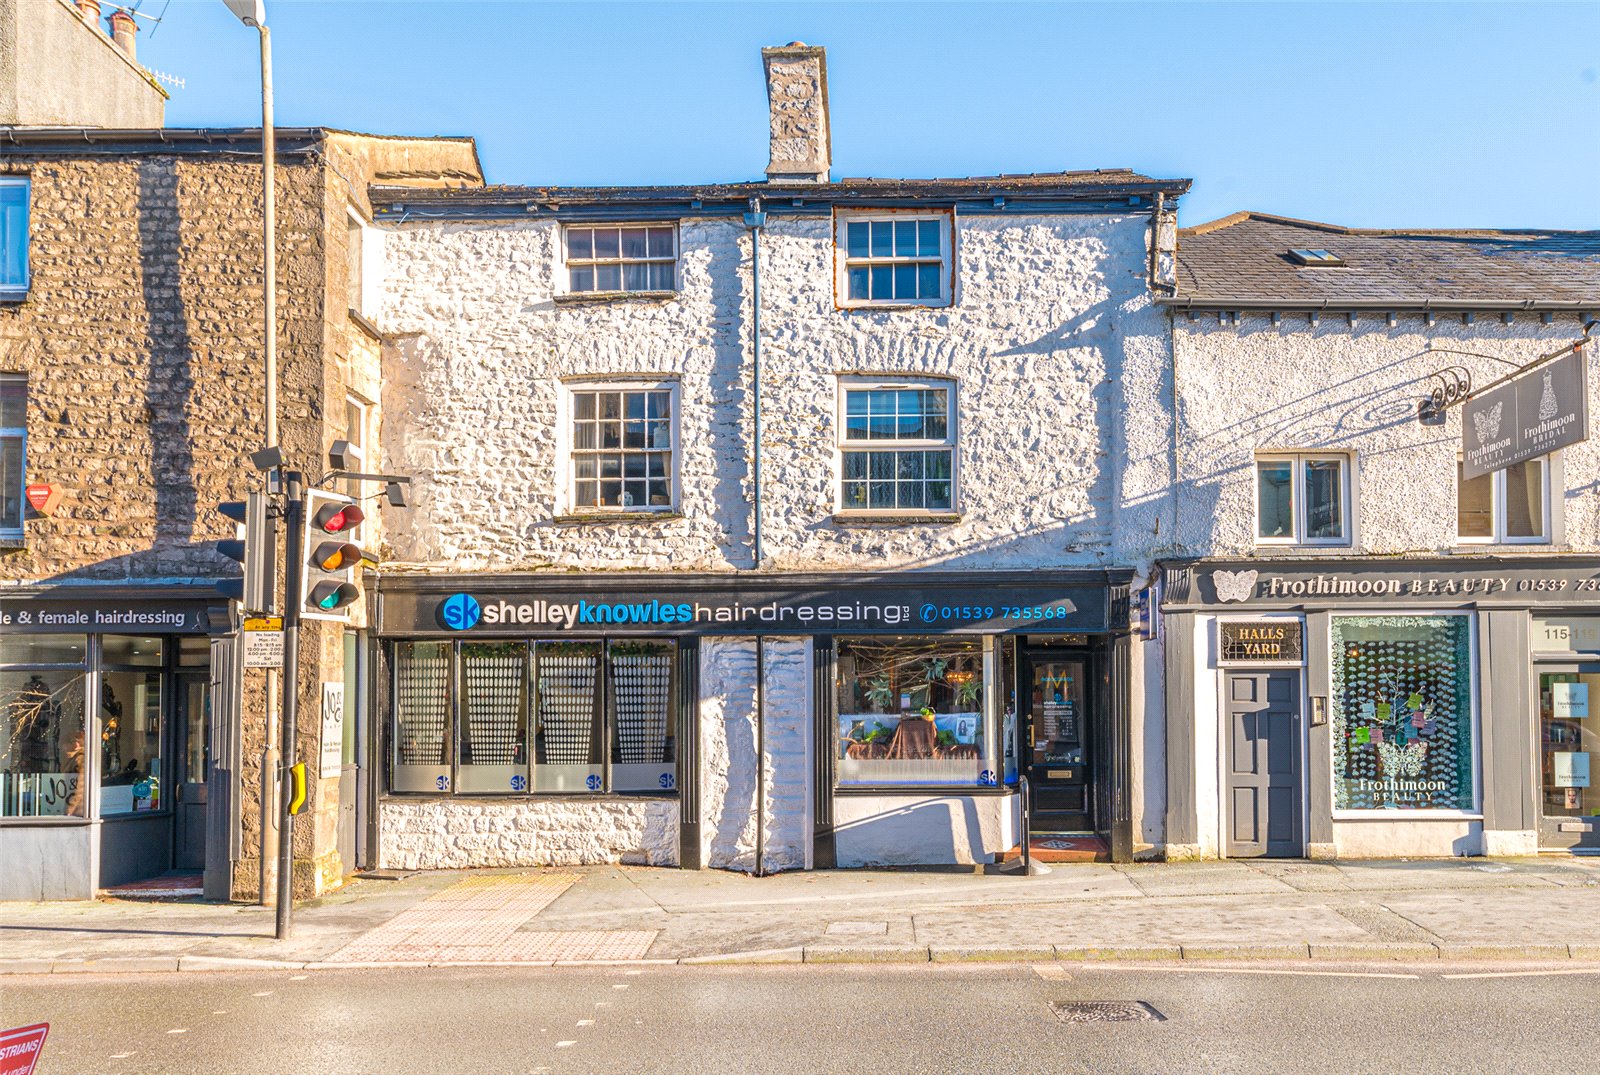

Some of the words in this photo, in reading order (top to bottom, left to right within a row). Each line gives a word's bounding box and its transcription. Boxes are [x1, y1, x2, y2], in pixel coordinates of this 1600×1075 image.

[1524, 412, 1575, 440] Frothimoon
[1533, 426, 1567, 445] BRIDAL
[1467, 437, 1511, 461] Frothimoon
[1474, 449, 1504, 466] BEAUTY
[1270, 575, 1401, 596] Frothimoon
[1411, 578, 1512, 593] BEAUTY
[1519, 579, 1568, 592] 01539
[1575, 579, 1600, 592] 73
[17, 610, 32, 625] &
[38, 610, 89, 625] female
[95, 610, 185, 627] hairdressing
[694, 601, 901, 625] hairdressing
[941, 606, 994, 620] 01539
[1001, 606, 1067, 620] 735568
[1239, 628, 1285, 640] HALLS
[1242, 643, 1281, 655] YARD
[1359, 778, 1446, 791] Frothimoon
[1373, 791, 1433, 801] BEAUTY
